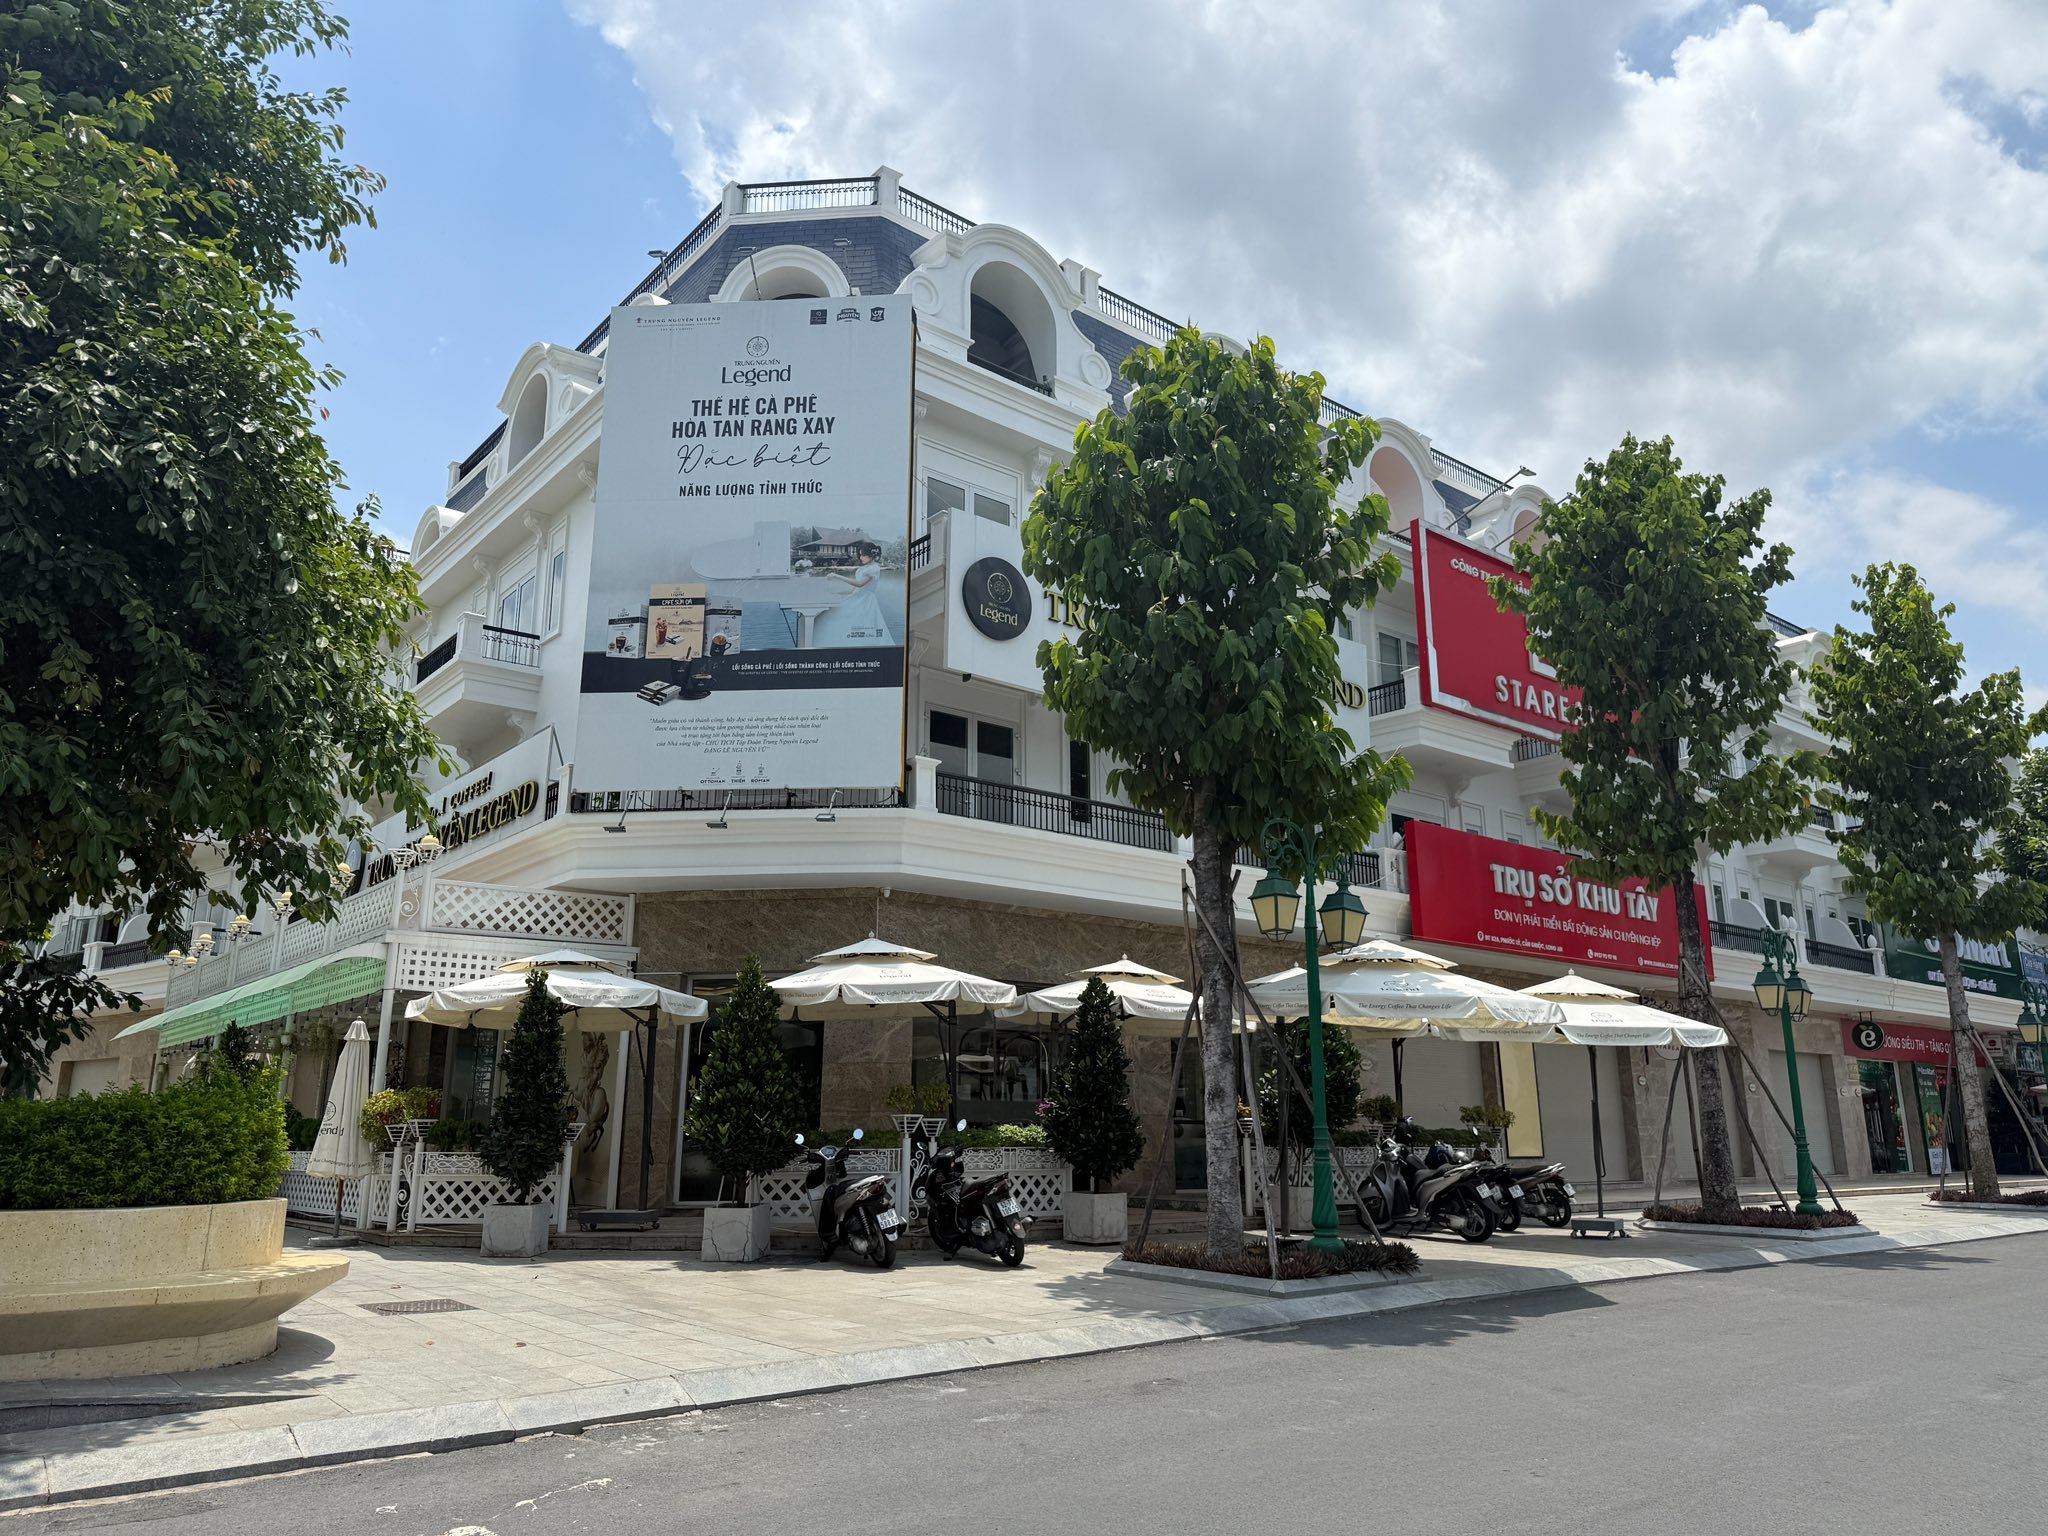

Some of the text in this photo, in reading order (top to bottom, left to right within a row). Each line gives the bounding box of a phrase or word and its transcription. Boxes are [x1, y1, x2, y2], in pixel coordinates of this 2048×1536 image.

[721, 364, 791, 387] Legend
[692, 393, 818, 418] THẾ HỆ CÀ PHÊ
[713, 419, 745, 437] TAN
[750, 417, 798, 437] RANG
[802, 416, 836, 435] XAY
[677, 442, 832, 475] Đặc biệt
[679, 479, 823, 498] NĂNG LƯỢNG TỈNH THỨC
[1450, 557, 1479, 578] CÔNG
[980, 603, 1018, 627] Legend
[469, 779, 540, 840] LEGEND
[1490, 863, 1659, 922] TRỤ SỞ KHU TÂY
[1494, 909, 1514, 922] ĐƠN
[1514, 913, 1523, 926] VỊ
[1522, 912, 1542, 927] PHÁT
[1542, 914, 1562, 931] TRIỂN
[1562, 918, 1576, 932] BẤT
[1575, 920, 1598, 938] ĐỘNG
[1598, 923, 1614, 940] SẢN
[1901, 1035, 1915, 1050] SIÊU
[1915, 1039, 1926, 1054] THỊ
